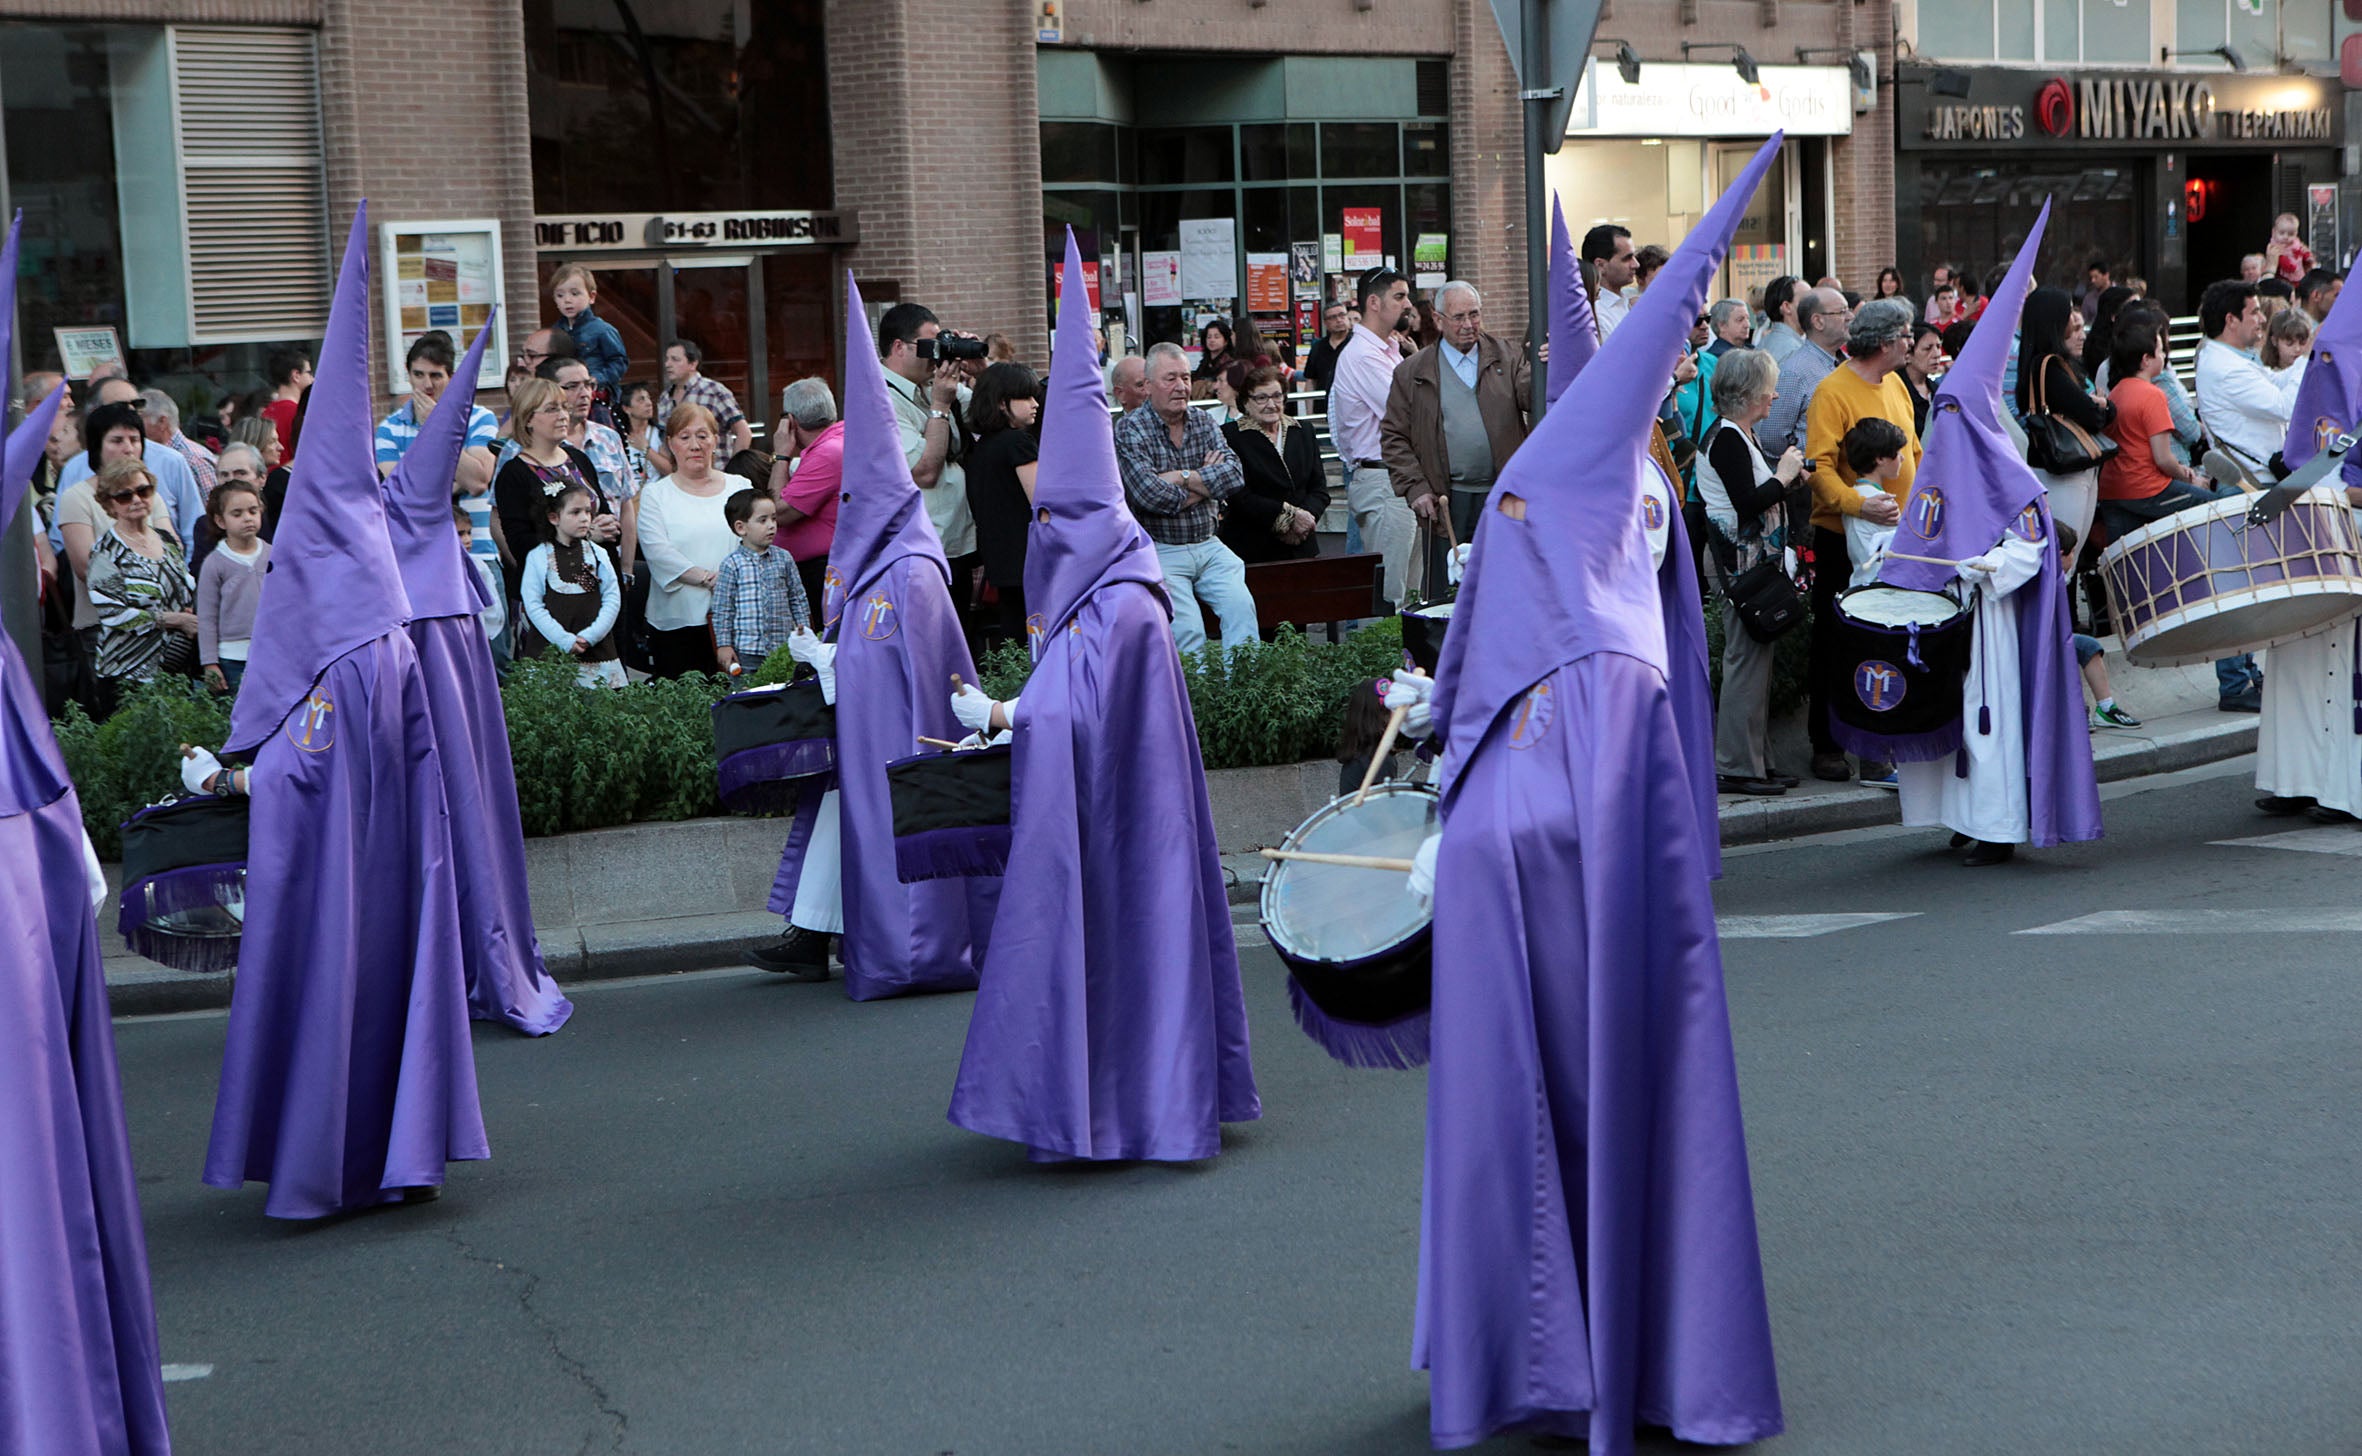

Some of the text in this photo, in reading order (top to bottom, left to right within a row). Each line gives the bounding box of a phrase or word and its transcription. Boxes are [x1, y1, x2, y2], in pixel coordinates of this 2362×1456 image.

[1689, 84, 1825, 120] Good Godis
[1931, 79, 2332, 140] JAPONES MIYAKO TEPPANYAKI
[535, 221, 624, 246] DIFICIO
[724, 216, 841, 240] ROBINSON
